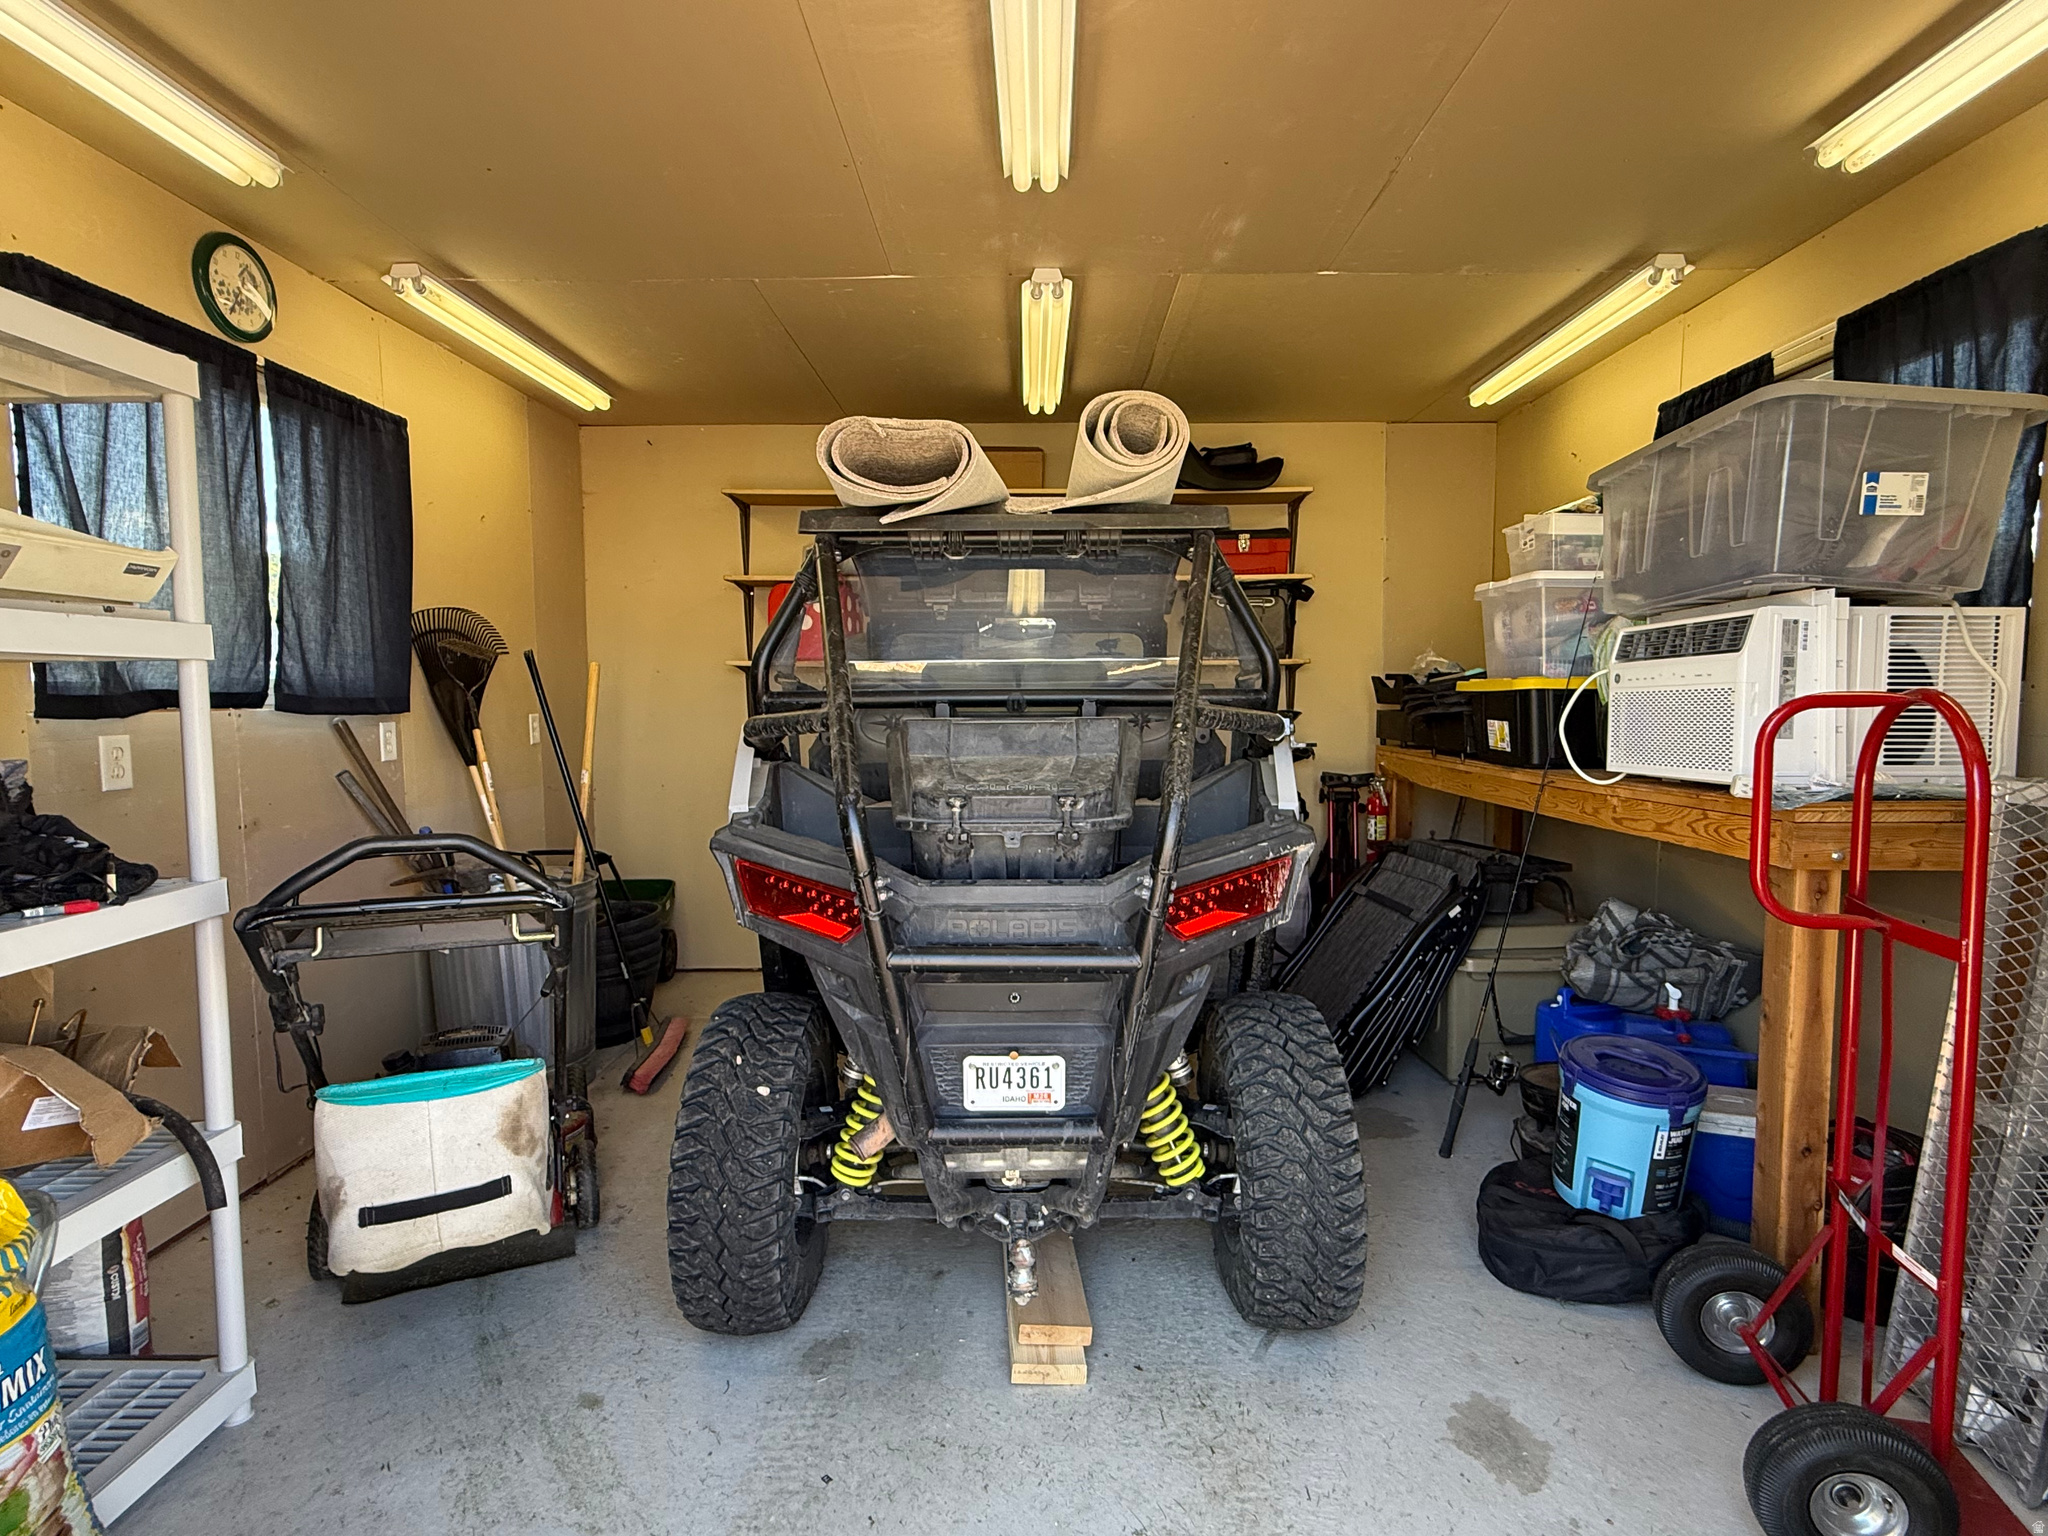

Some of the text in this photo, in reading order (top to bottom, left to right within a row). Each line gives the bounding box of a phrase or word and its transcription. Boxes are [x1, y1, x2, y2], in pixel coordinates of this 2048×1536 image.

[942, 783, 1080, 791] POLARIS
[947, 919, 1077, 938] POLARIS
[976, 1066, 1052, 1089] RU4361
[1670, 1128, 1691, 1138] WATER
[1668, 1137, 1683, 1145] JUG
[1, 1346, 47, 1409] MIX
